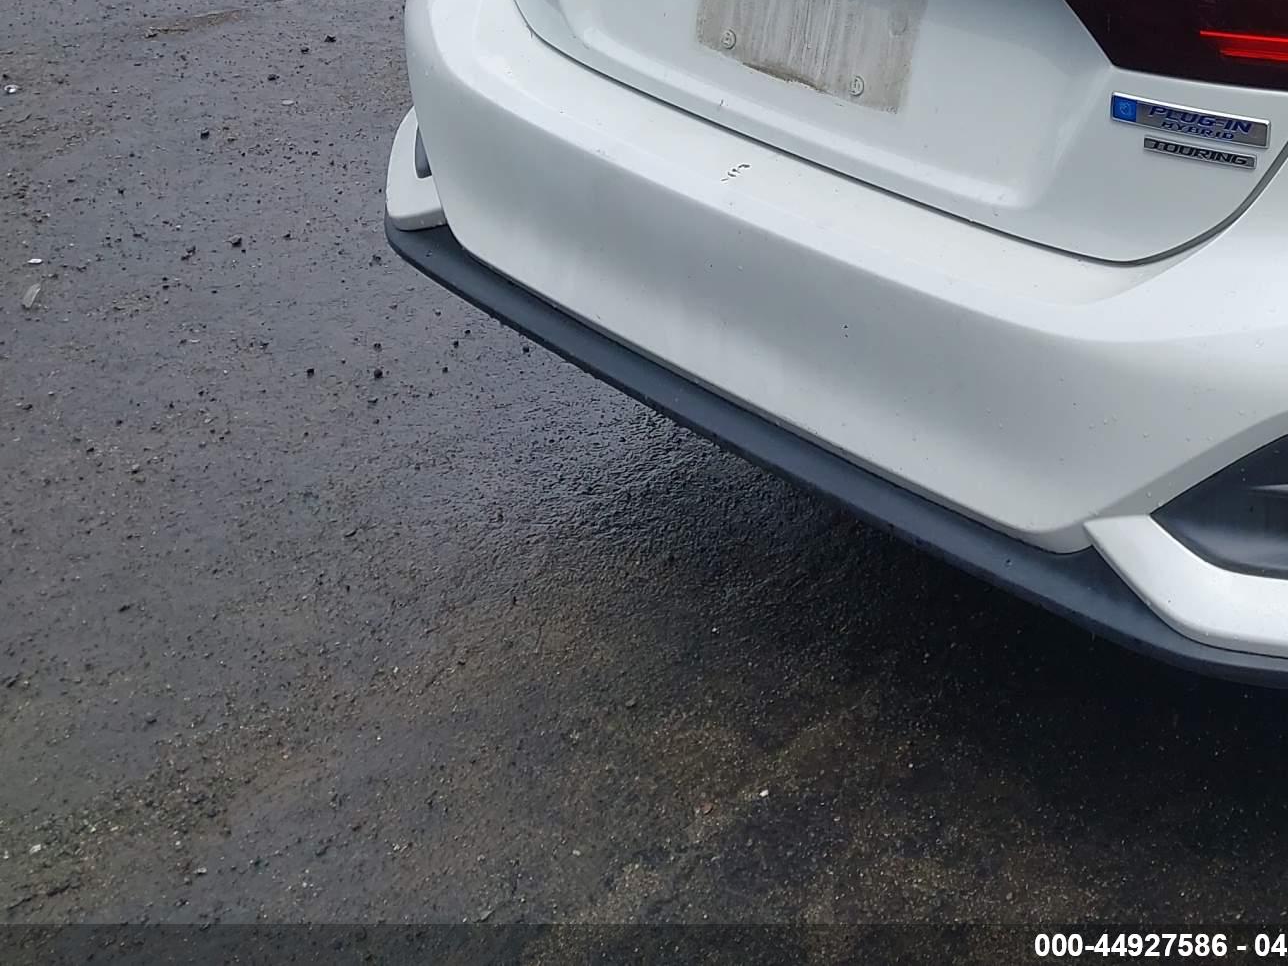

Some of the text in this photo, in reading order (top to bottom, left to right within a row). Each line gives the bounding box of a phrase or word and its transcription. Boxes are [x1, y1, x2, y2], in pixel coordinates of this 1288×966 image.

[1148, 105, 1252, 133] PLUG-IN
[1161, 121, 1234, 140] HYBRID
[1151, 140, 1247, 165] TOURING
